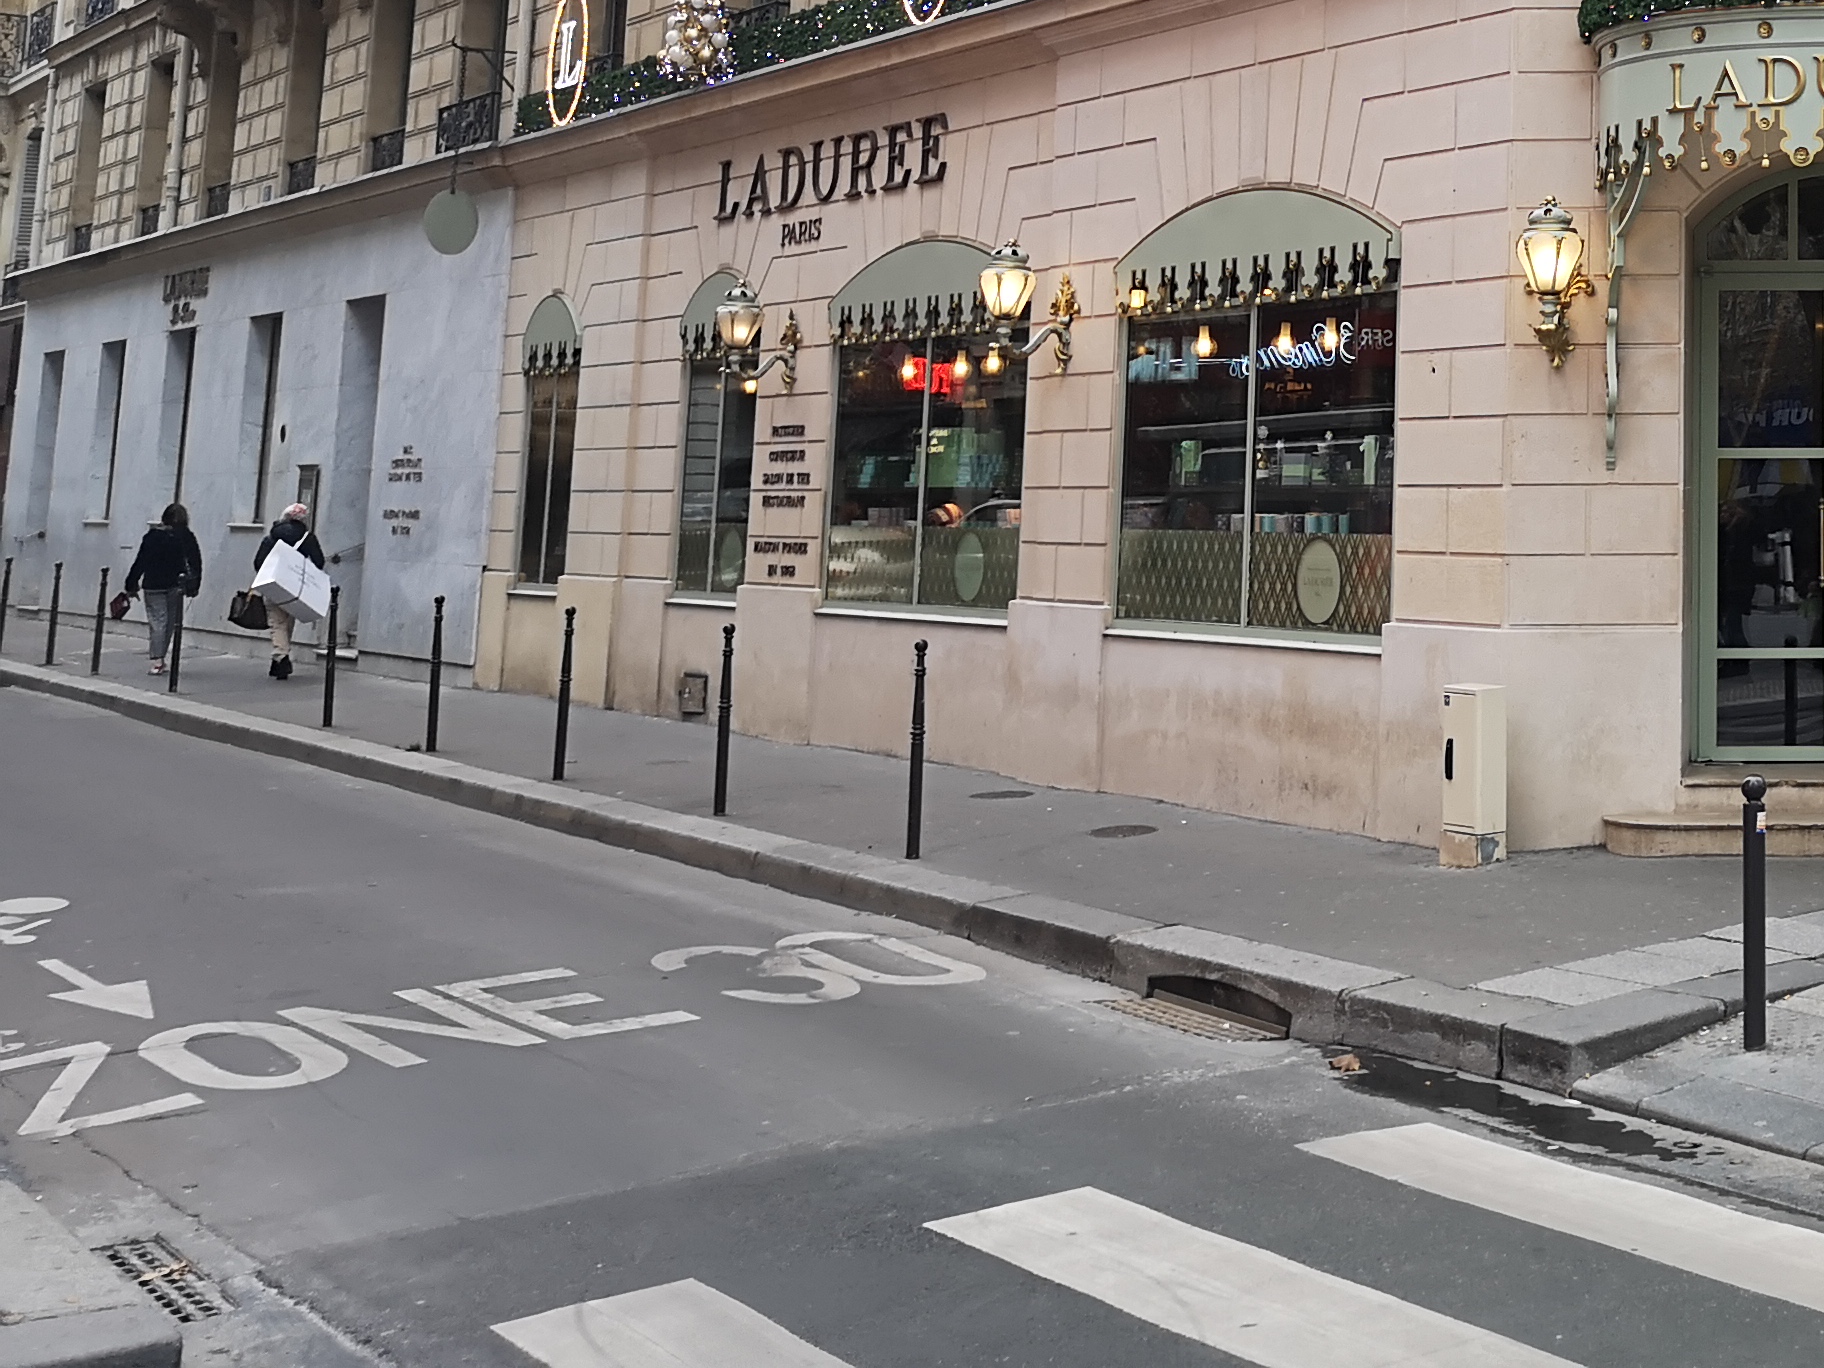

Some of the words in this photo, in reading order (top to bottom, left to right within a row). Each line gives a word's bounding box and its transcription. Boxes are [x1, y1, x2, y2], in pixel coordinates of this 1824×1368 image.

[555, 20, 583, 90] L
[713, 112, 949, 221] LADUREE
[780, 217, 823, 248] PARIS
[0, 967, 701, 1137] ZONE
[650, 930, 987, 1005] 30
